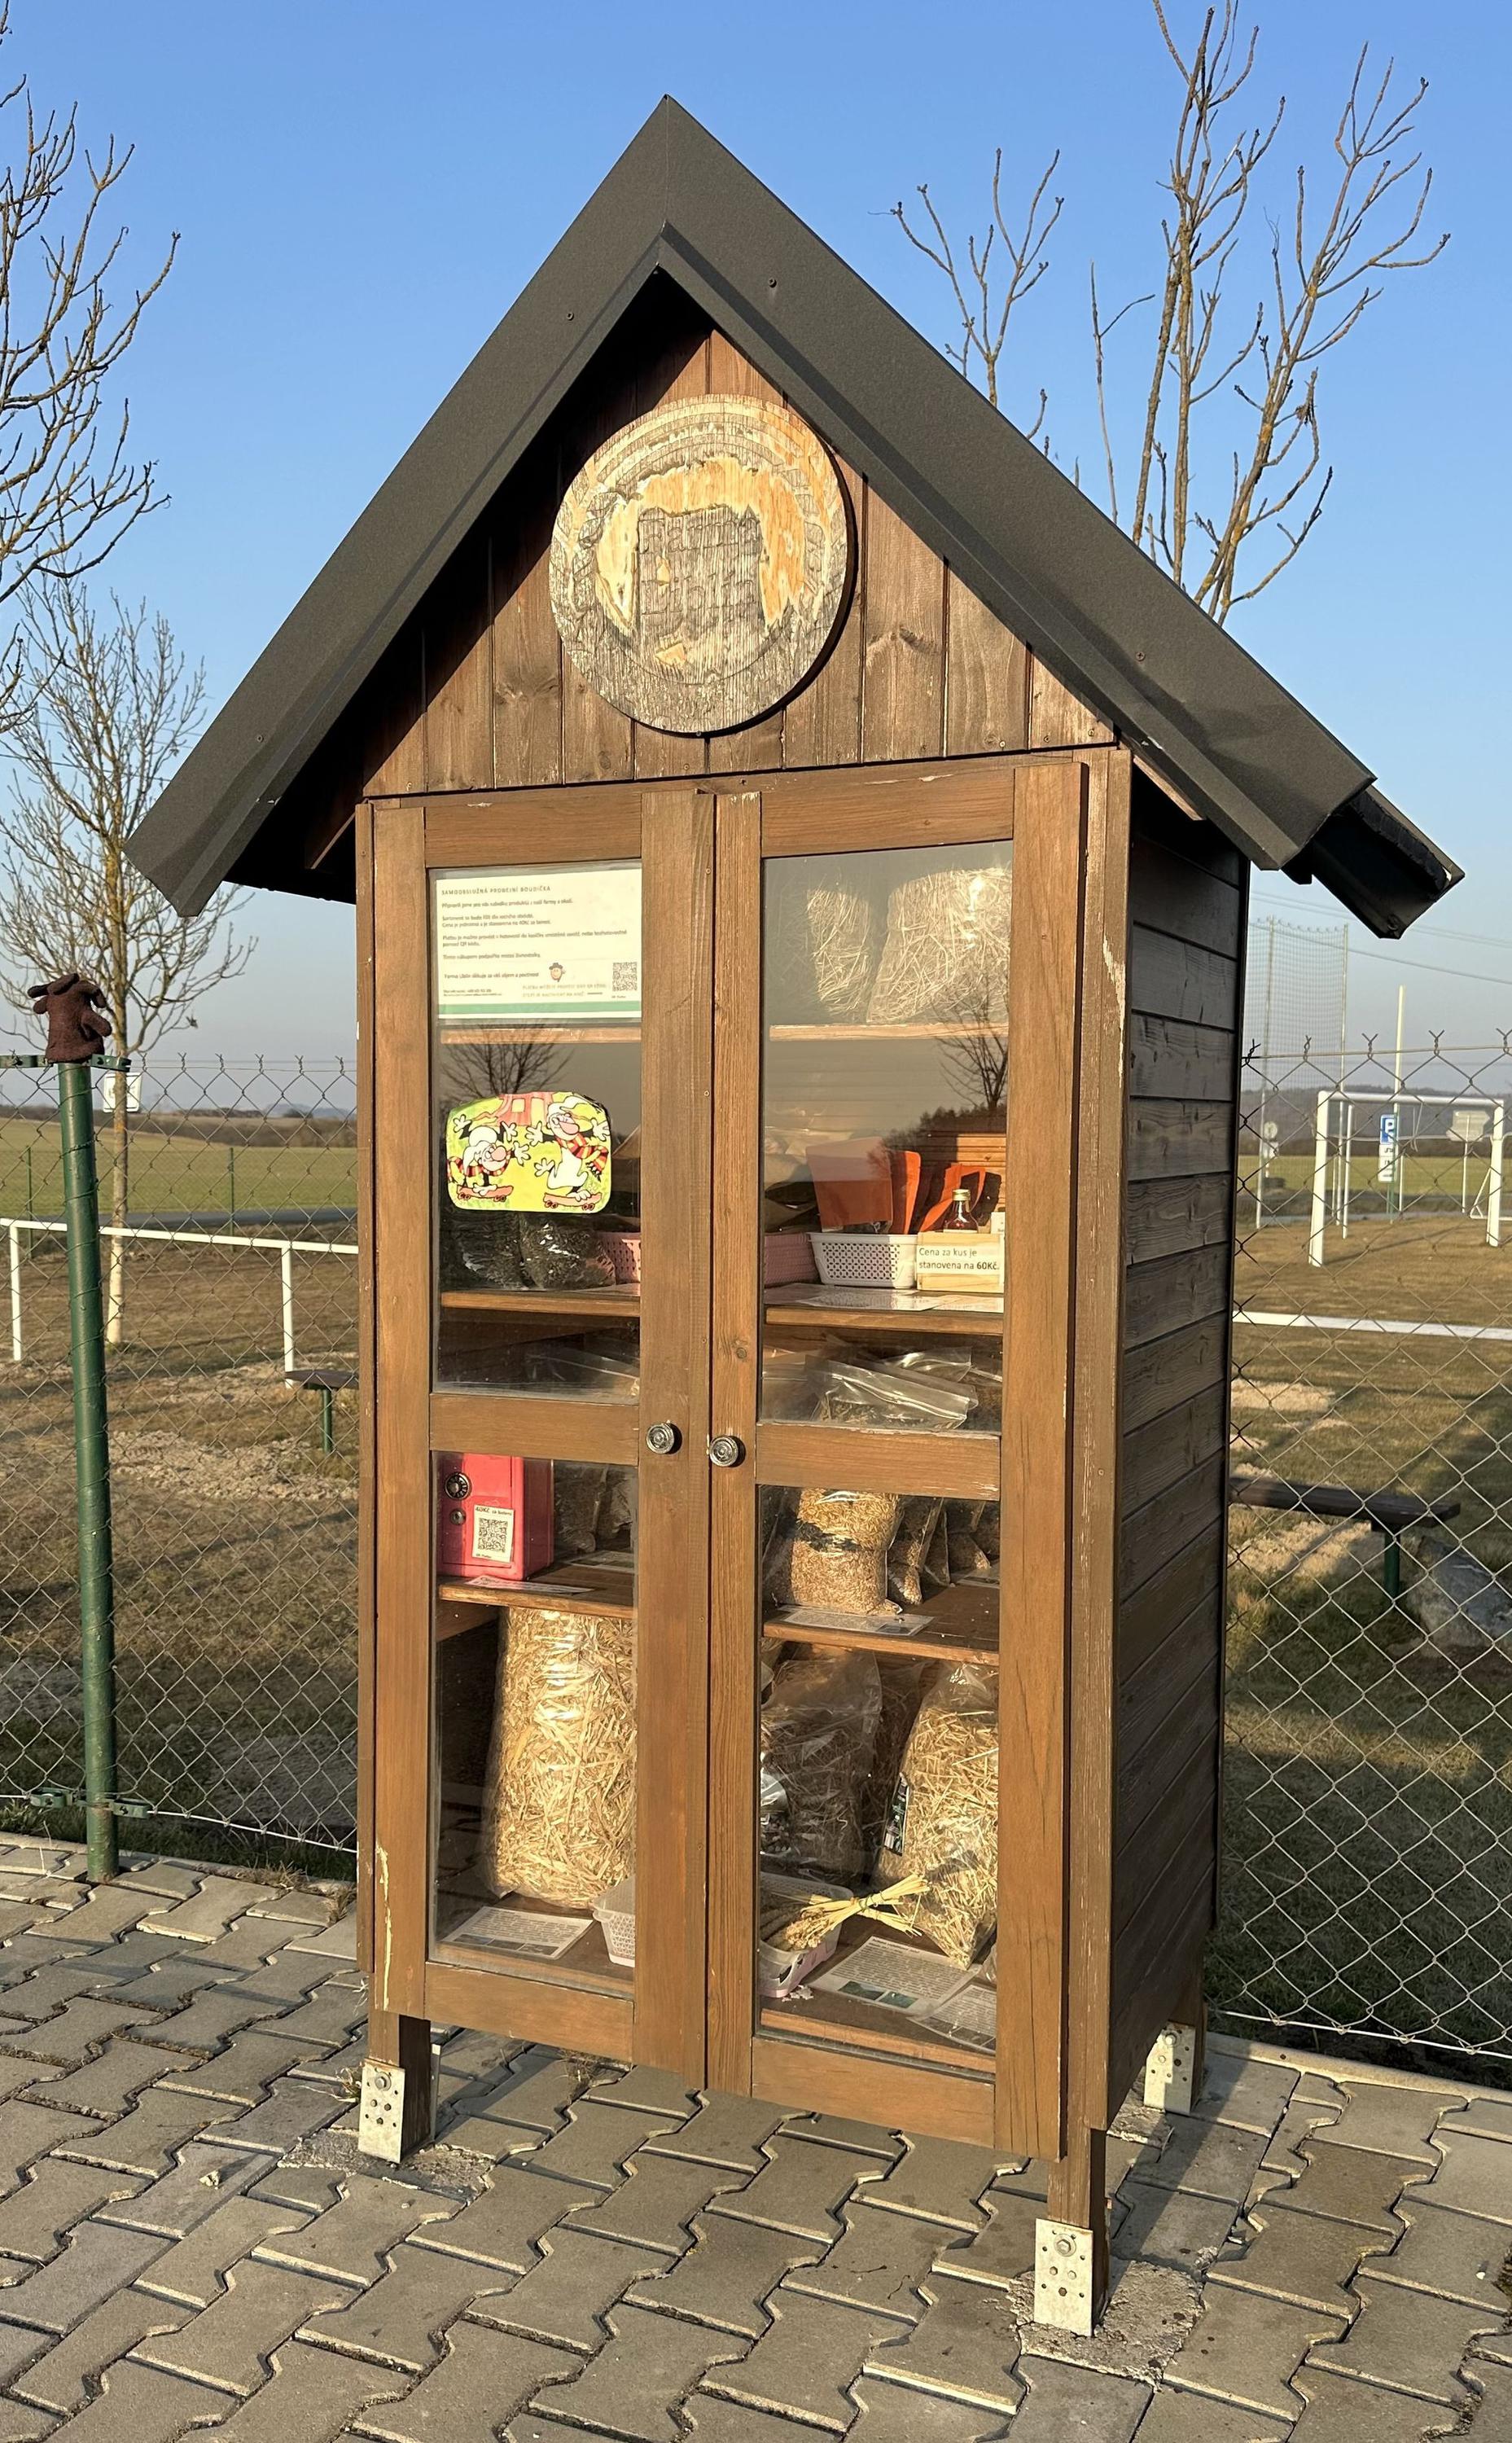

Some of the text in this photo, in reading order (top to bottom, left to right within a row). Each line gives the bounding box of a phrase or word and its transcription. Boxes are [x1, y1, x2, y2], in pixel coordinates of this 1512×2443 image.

[638, 519, 761, 555] Farma
[918, 1248, 940, 1257] Cena
[953, 1248, 967, 1257] kus
[969, 1248, 977, 1259] je
[918, 1261, 962, 1270] stanovena
